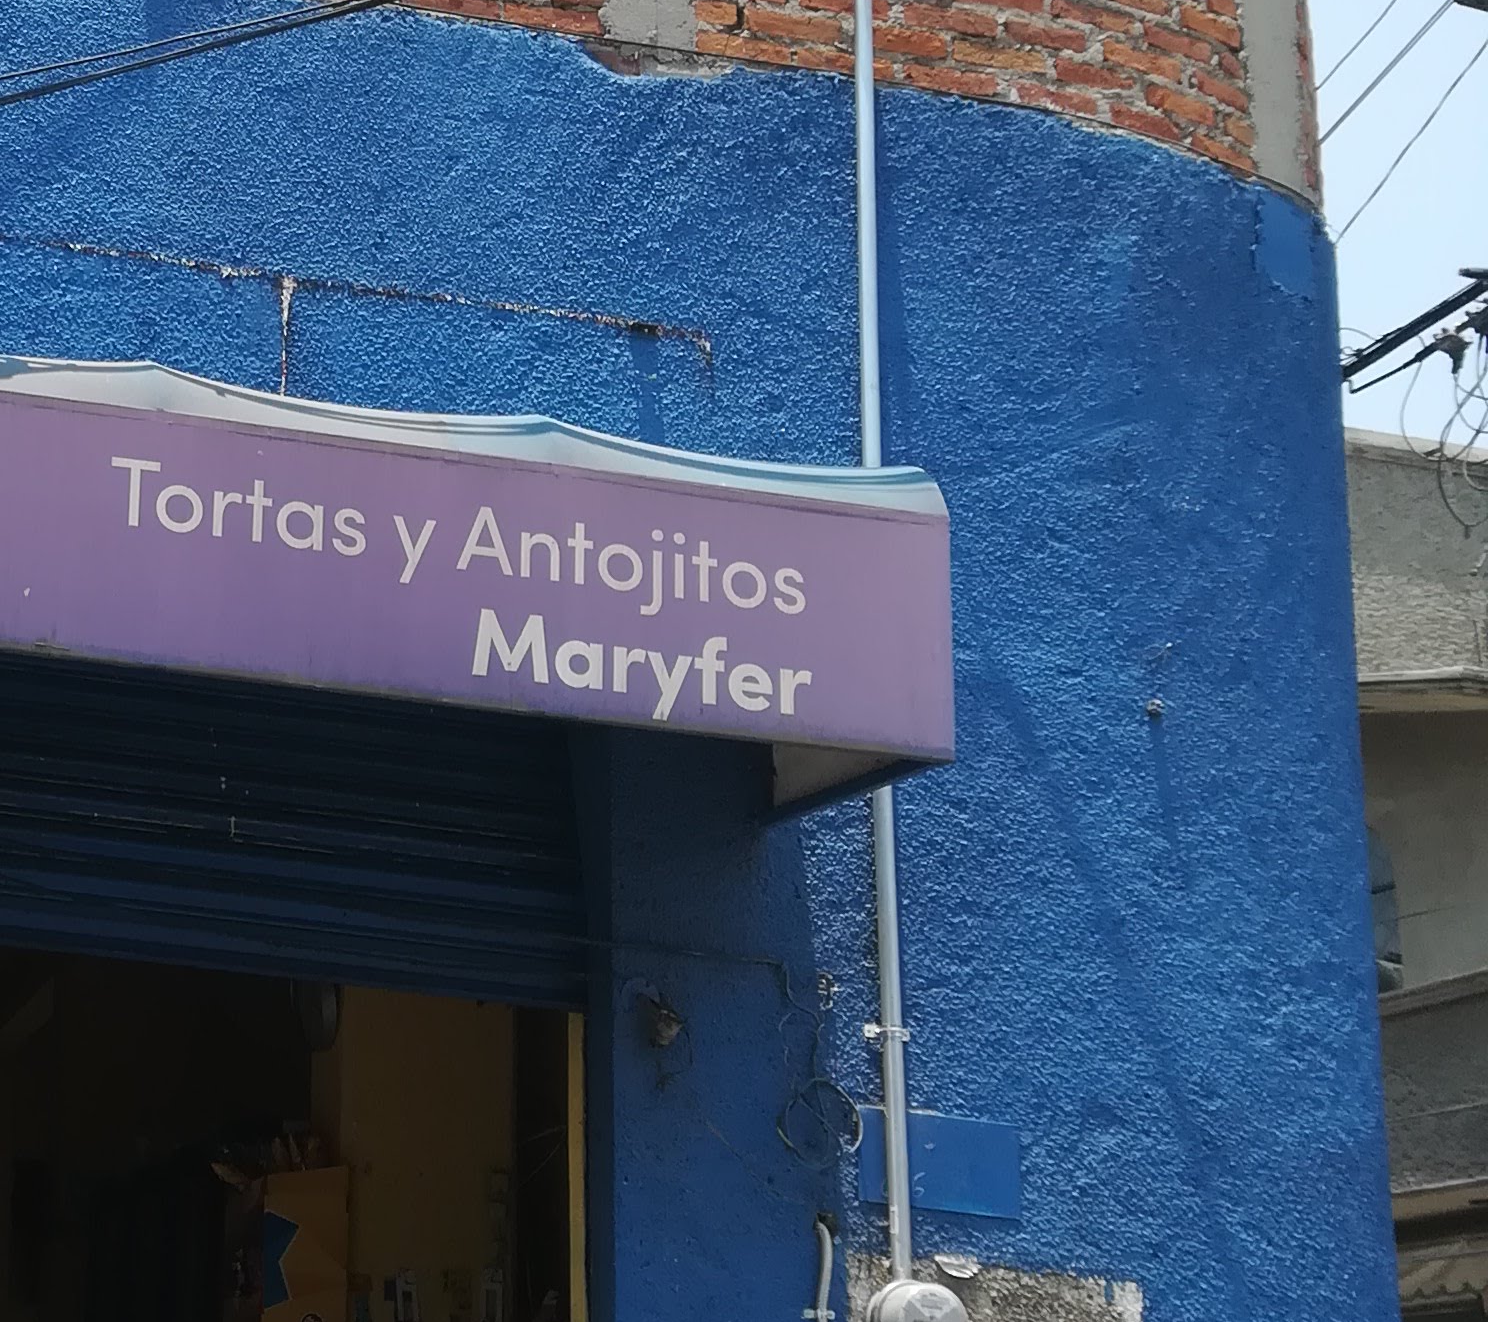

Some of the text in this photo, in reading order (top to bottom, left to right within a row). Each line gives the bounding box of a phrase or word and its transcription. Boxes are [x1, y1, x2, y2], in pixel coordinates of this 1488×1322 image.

[110, 456, 808, 617] Tortas y Antojitos
[471, 608, 814, 721] Maryfer
